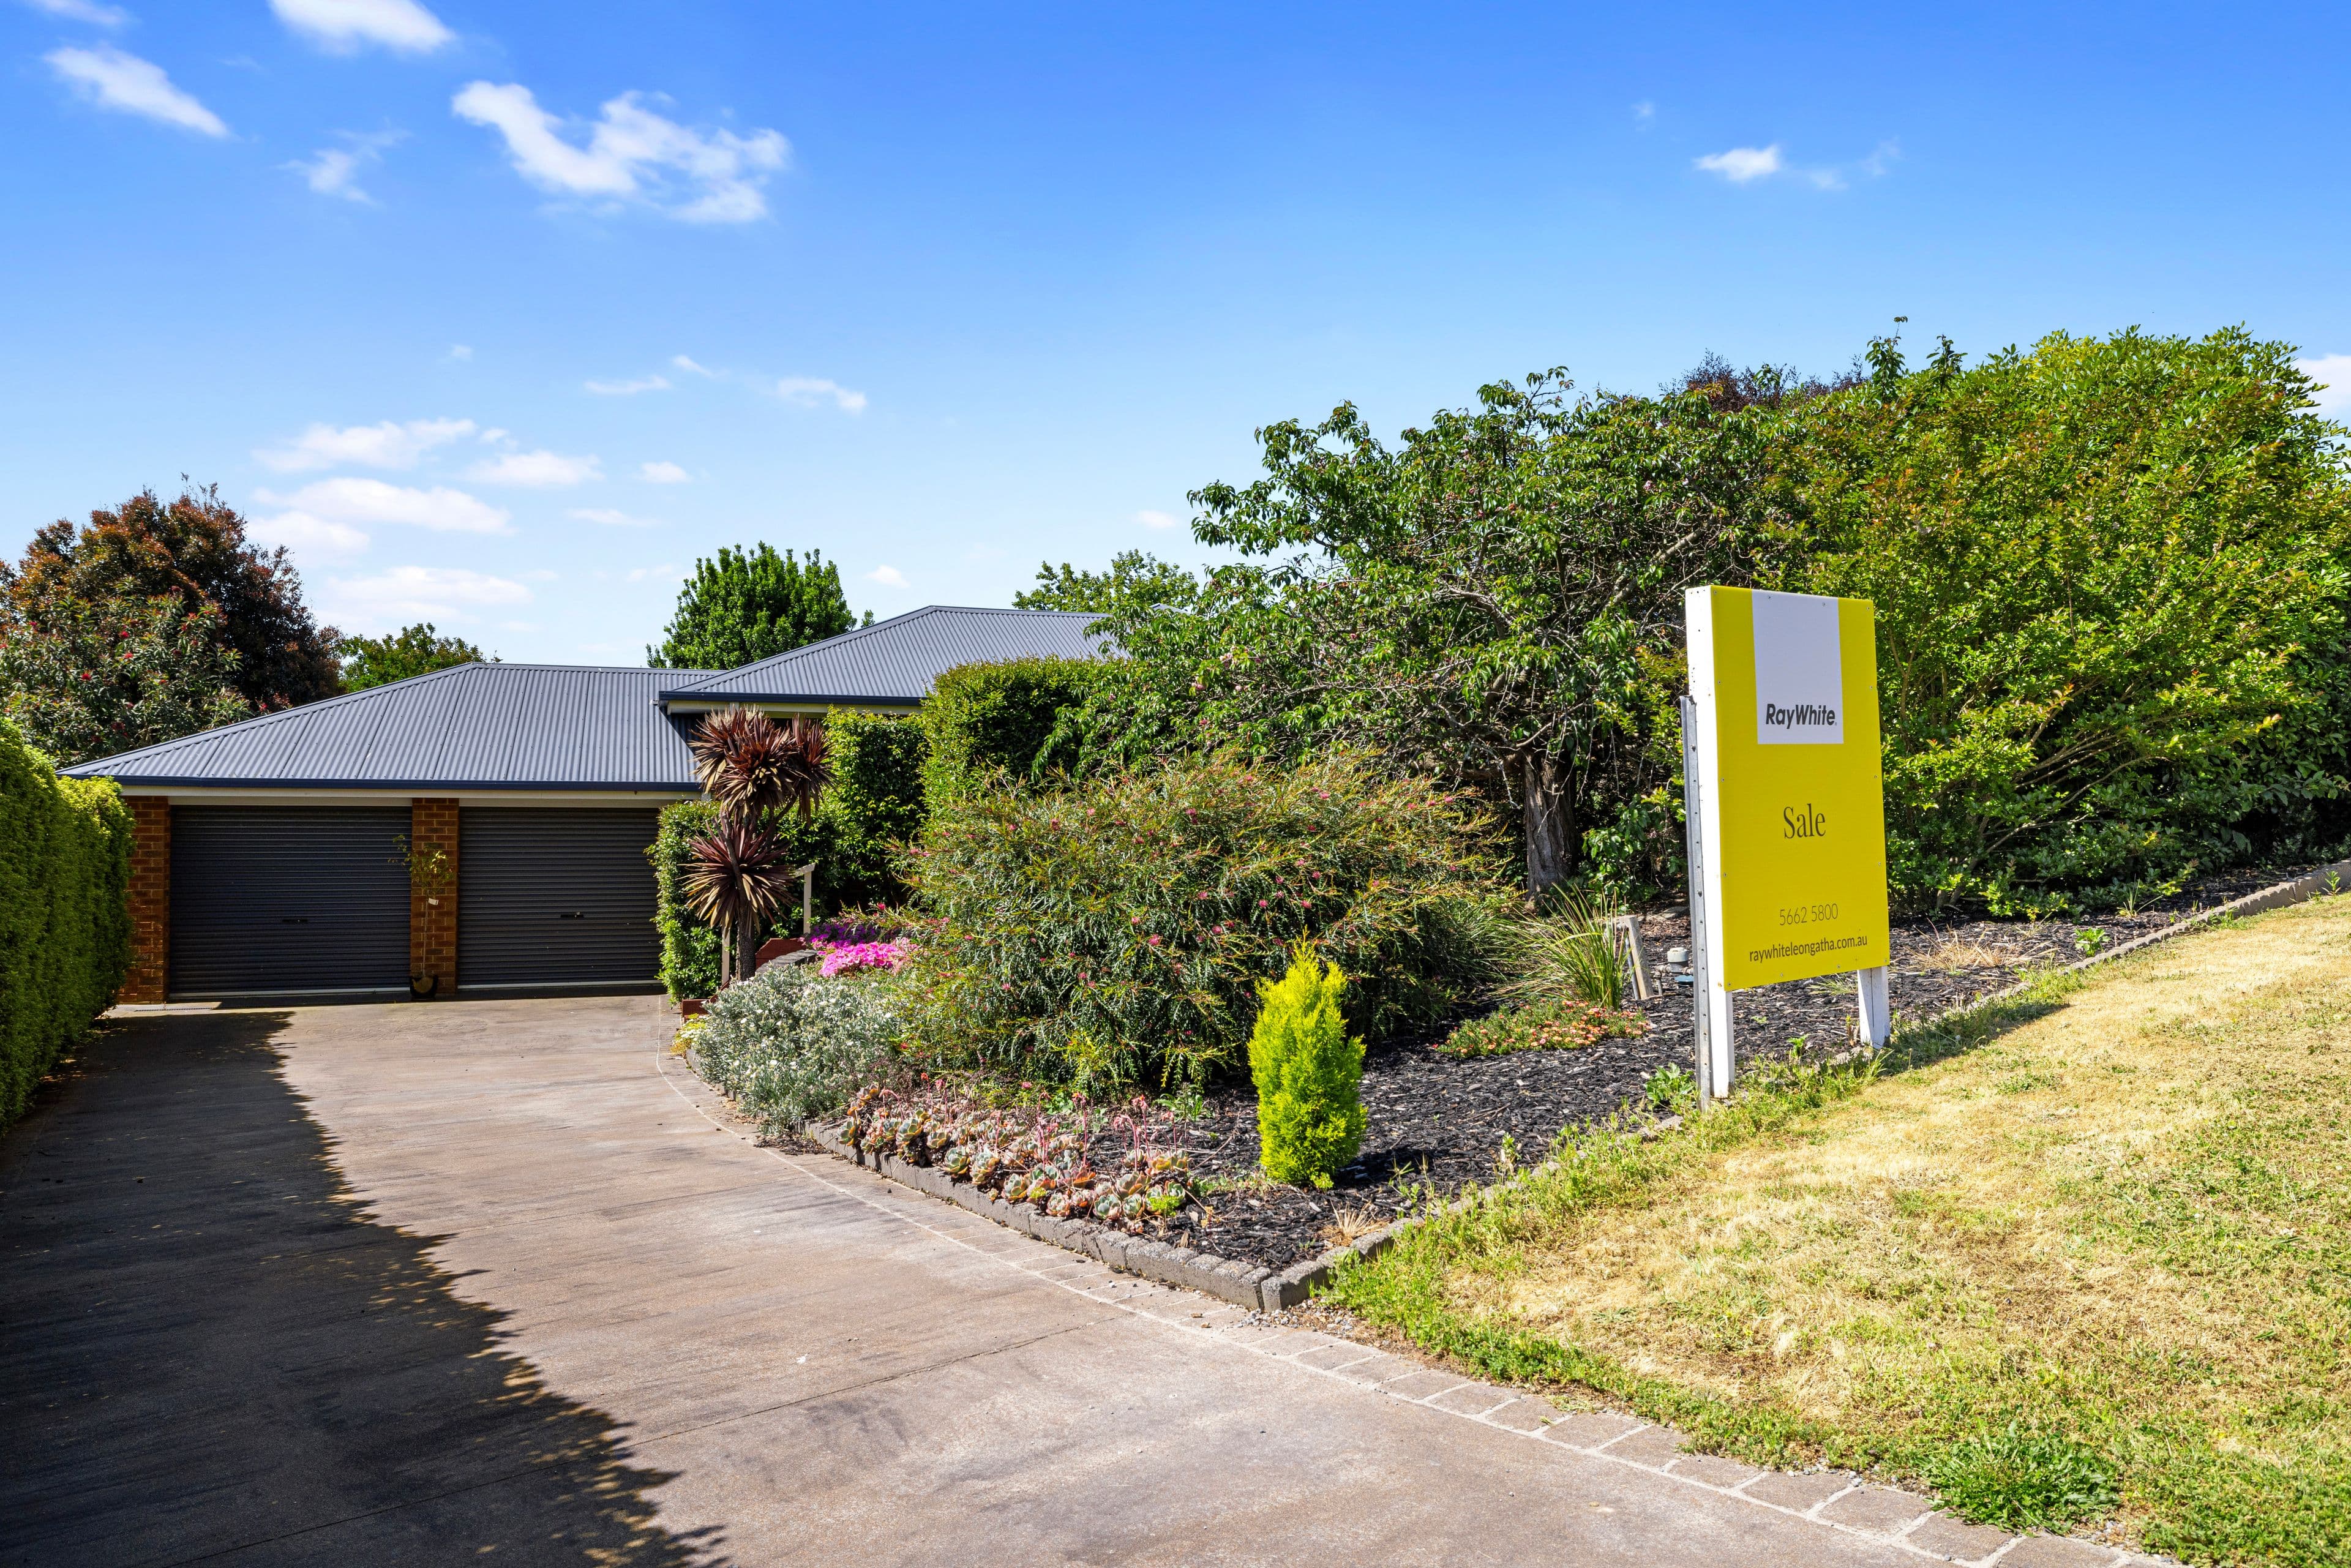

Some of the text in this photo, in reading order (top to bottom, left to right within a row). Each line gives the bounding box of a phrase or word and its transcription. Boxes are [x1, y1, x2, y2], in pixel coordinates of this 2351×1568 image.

[1783, 803, 1826, 839] Sale
[1779, 903, 1838, 926] 5662 5800
[1749, 934, 1867, 963] raywhiteleongatha.com.au
